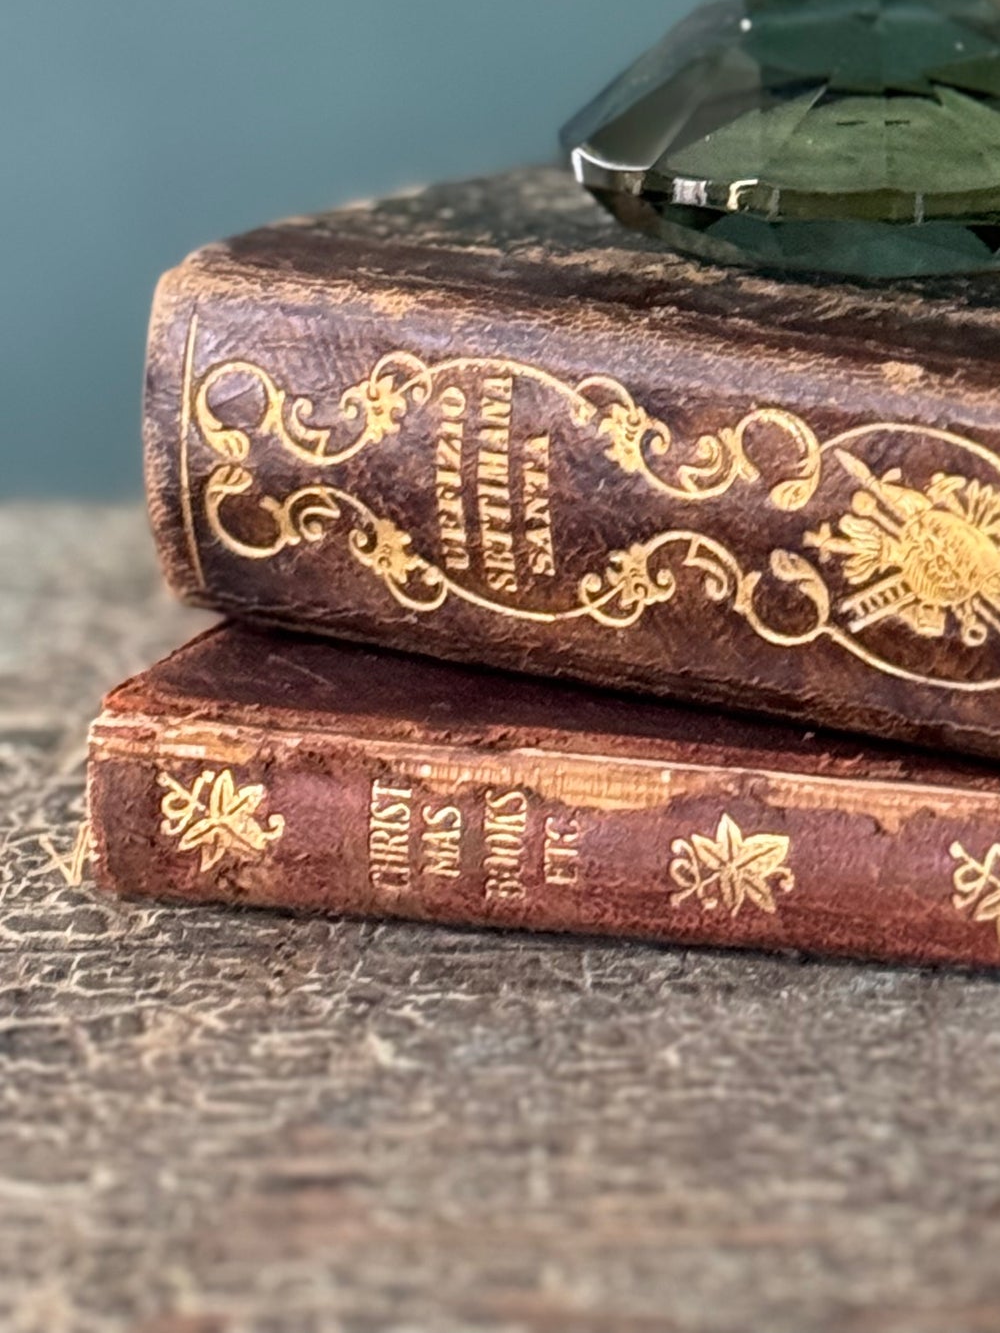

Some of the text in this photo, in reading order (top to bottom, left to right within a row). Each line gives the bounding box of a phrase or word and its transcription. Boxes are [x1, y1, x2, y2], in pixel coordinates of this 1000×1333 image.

[436, 386, 469, 569] UFFIZIO
[477, 377, 517, 592] SETTIMANA
[523, 435, 554, 576] SANTA
[370, 779, 412, 890] CHRIST
[421, 805, 462, 877] MAS
[483, 790, 527, 900] BOOKS
